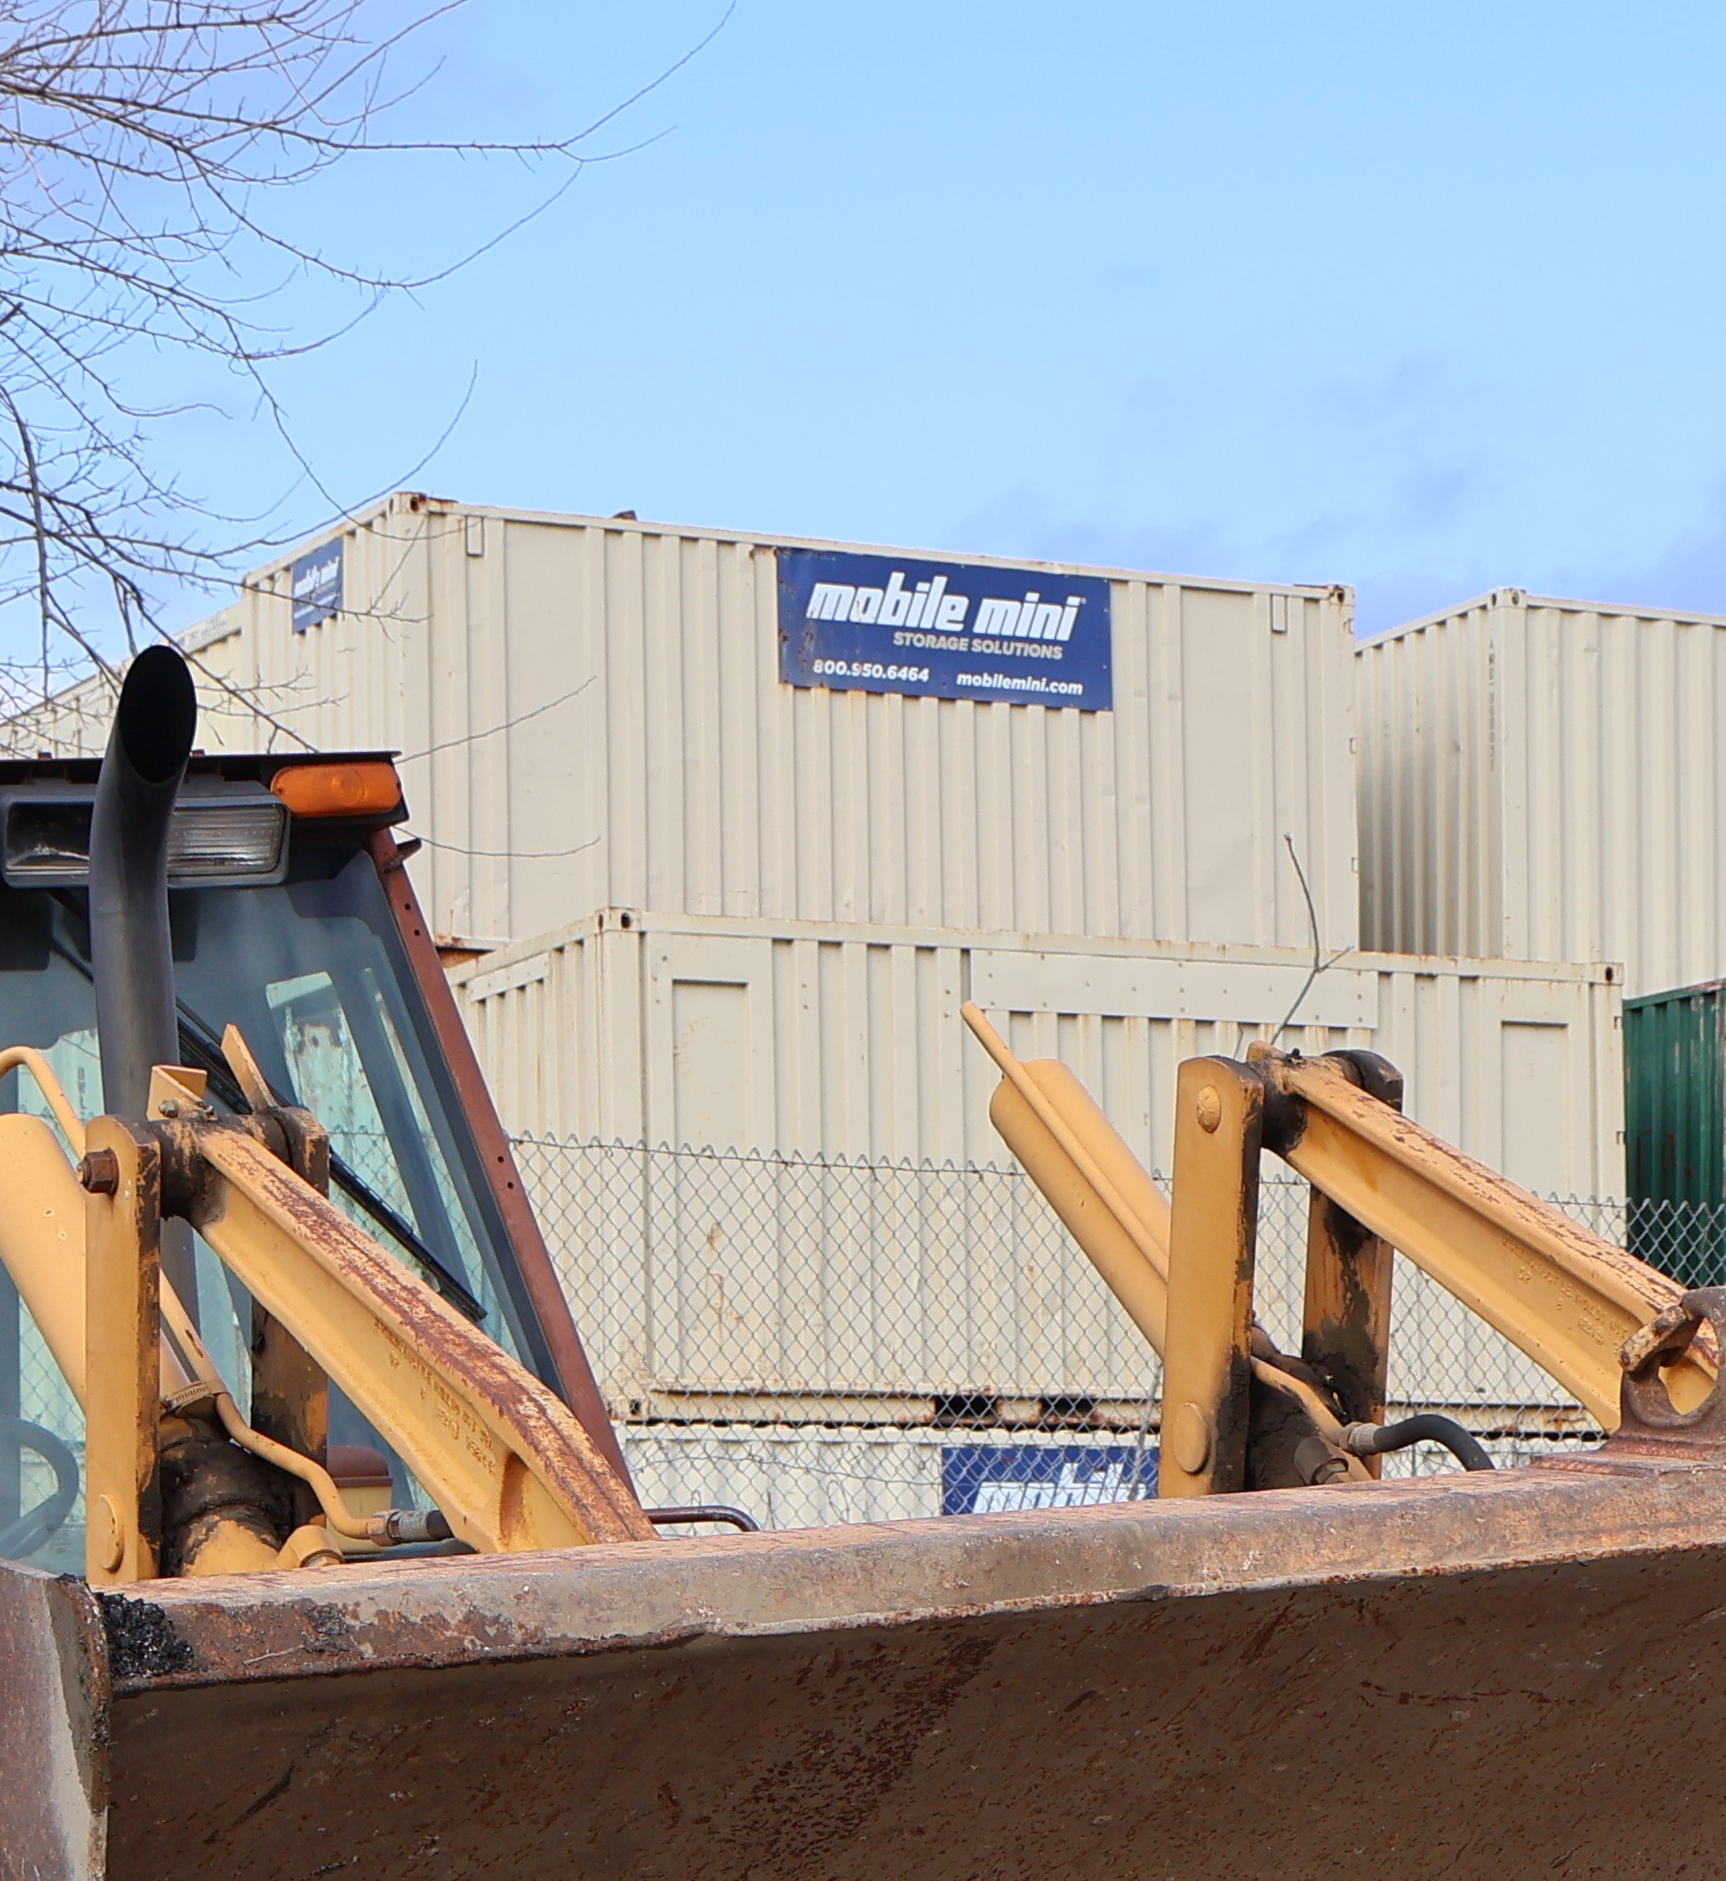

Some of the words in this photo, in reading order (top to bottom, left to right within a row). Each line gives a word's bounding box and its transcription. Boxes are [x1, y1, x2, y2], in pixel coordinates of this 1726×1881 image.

[806, 572, 969, 632] mobile
[973, 592, 1082, 641] mini
[893, 631, 968, 652] STORAGE
[971, 639, 1063, 660] SOLUTIONS
[813, 659, 930, 683] 800.950.6464
[957, 672, 1083, 696] mobilemini.com
